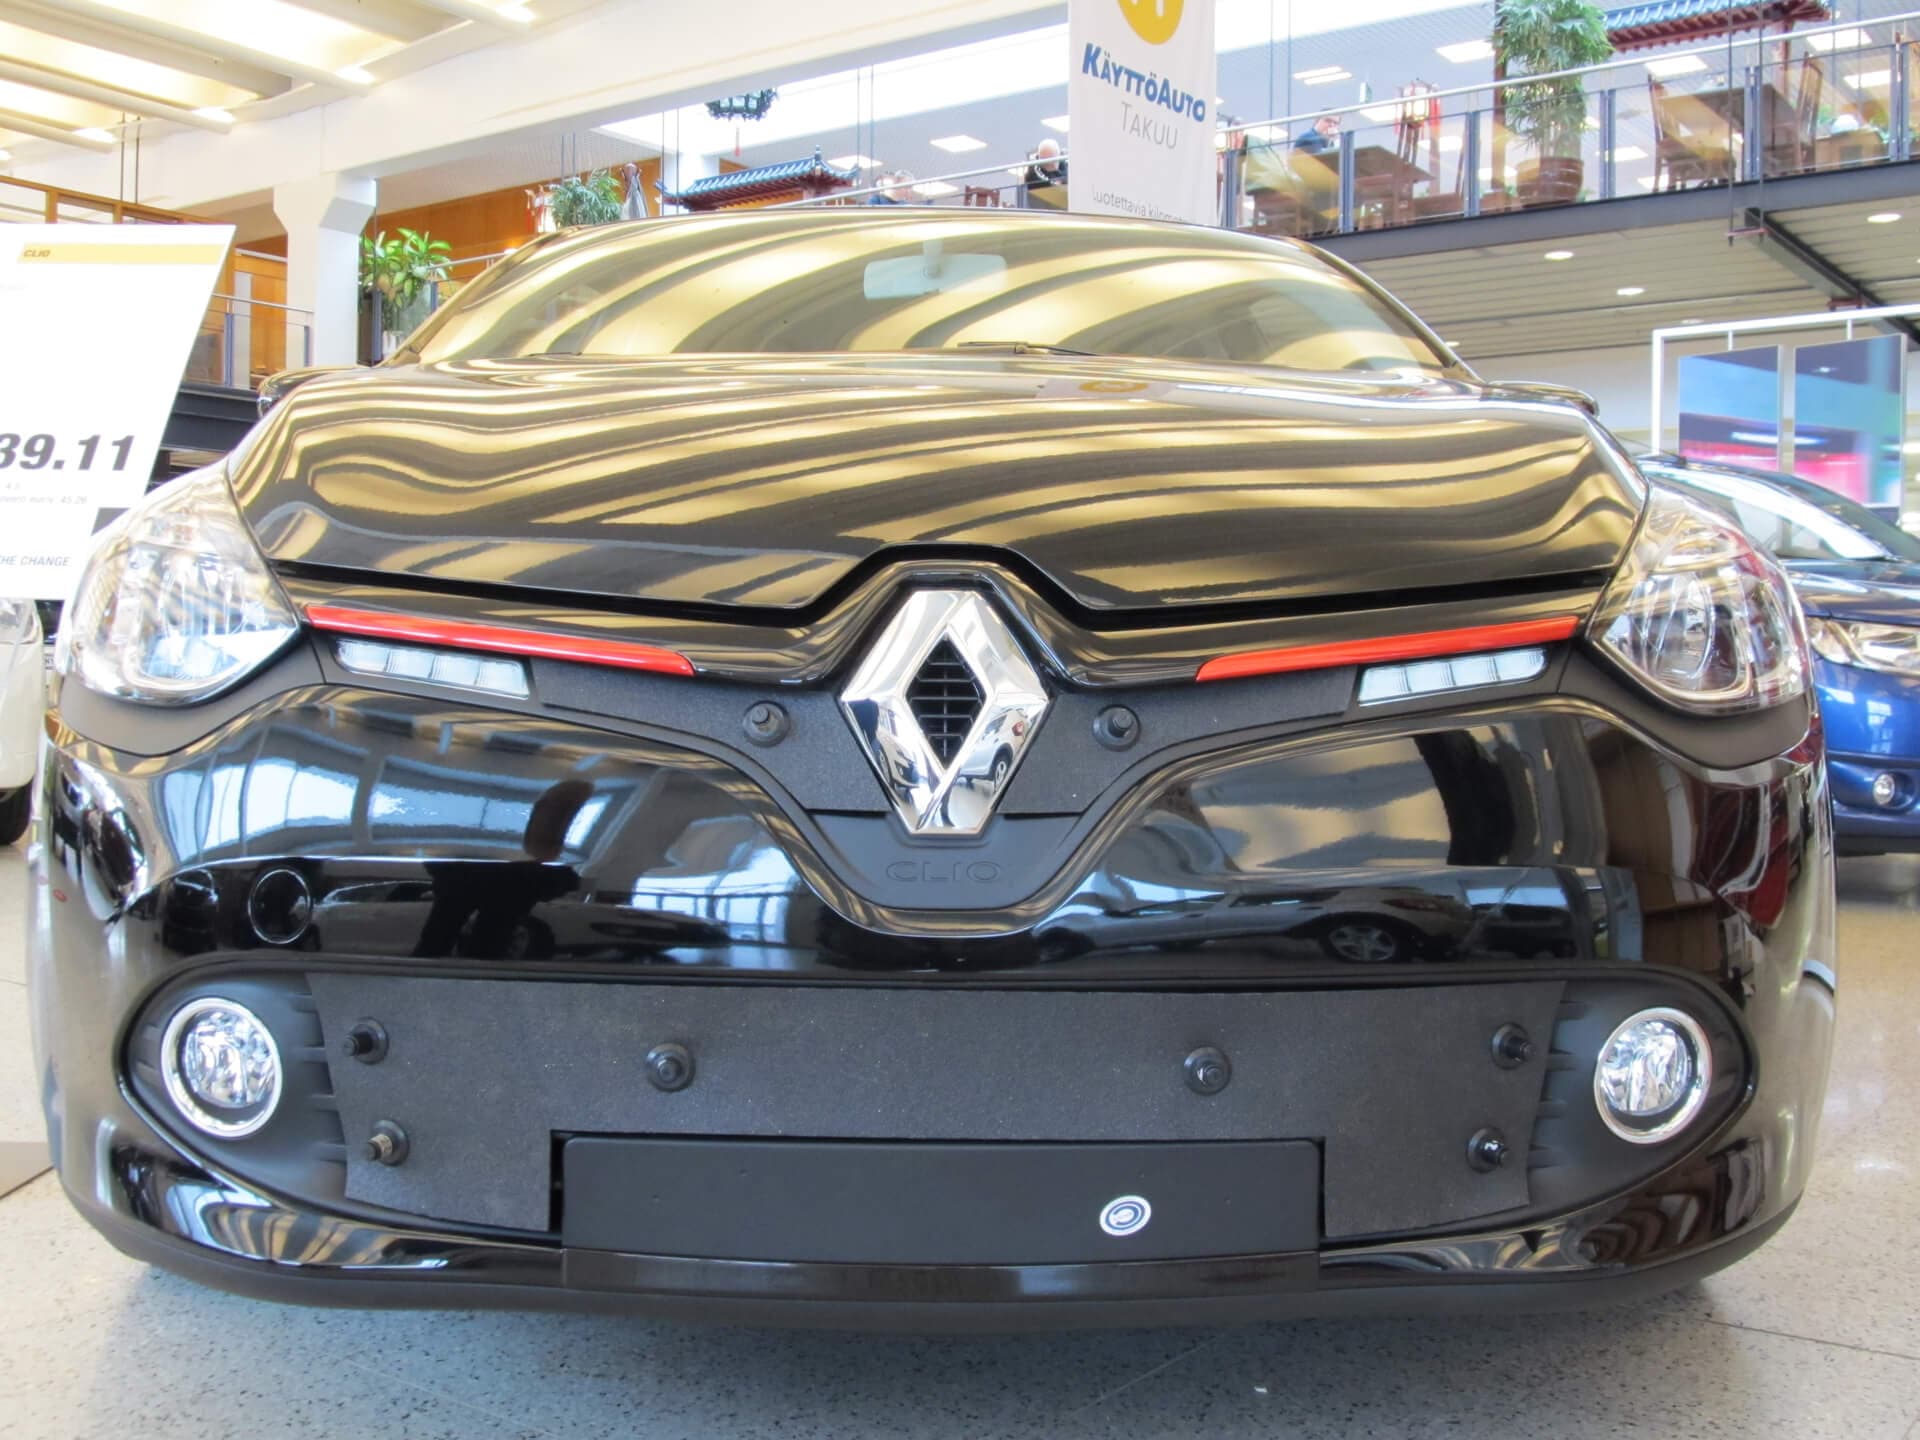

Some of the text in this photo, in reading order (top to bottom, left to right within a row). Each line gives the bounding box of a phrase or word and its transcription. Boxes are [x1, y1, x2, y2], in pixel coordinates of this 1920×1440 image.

[1082, 43, 1206, 122] KÄYTTÖAUTO
[1121, 101, 1178, 150] TAKUU
[23, 249, 51, 258] CLIO
[0, 433, 135, 471] 39.11
[20, 556, 71, 567] CHANGE
[886, 861, 1001, 882] CLIO
